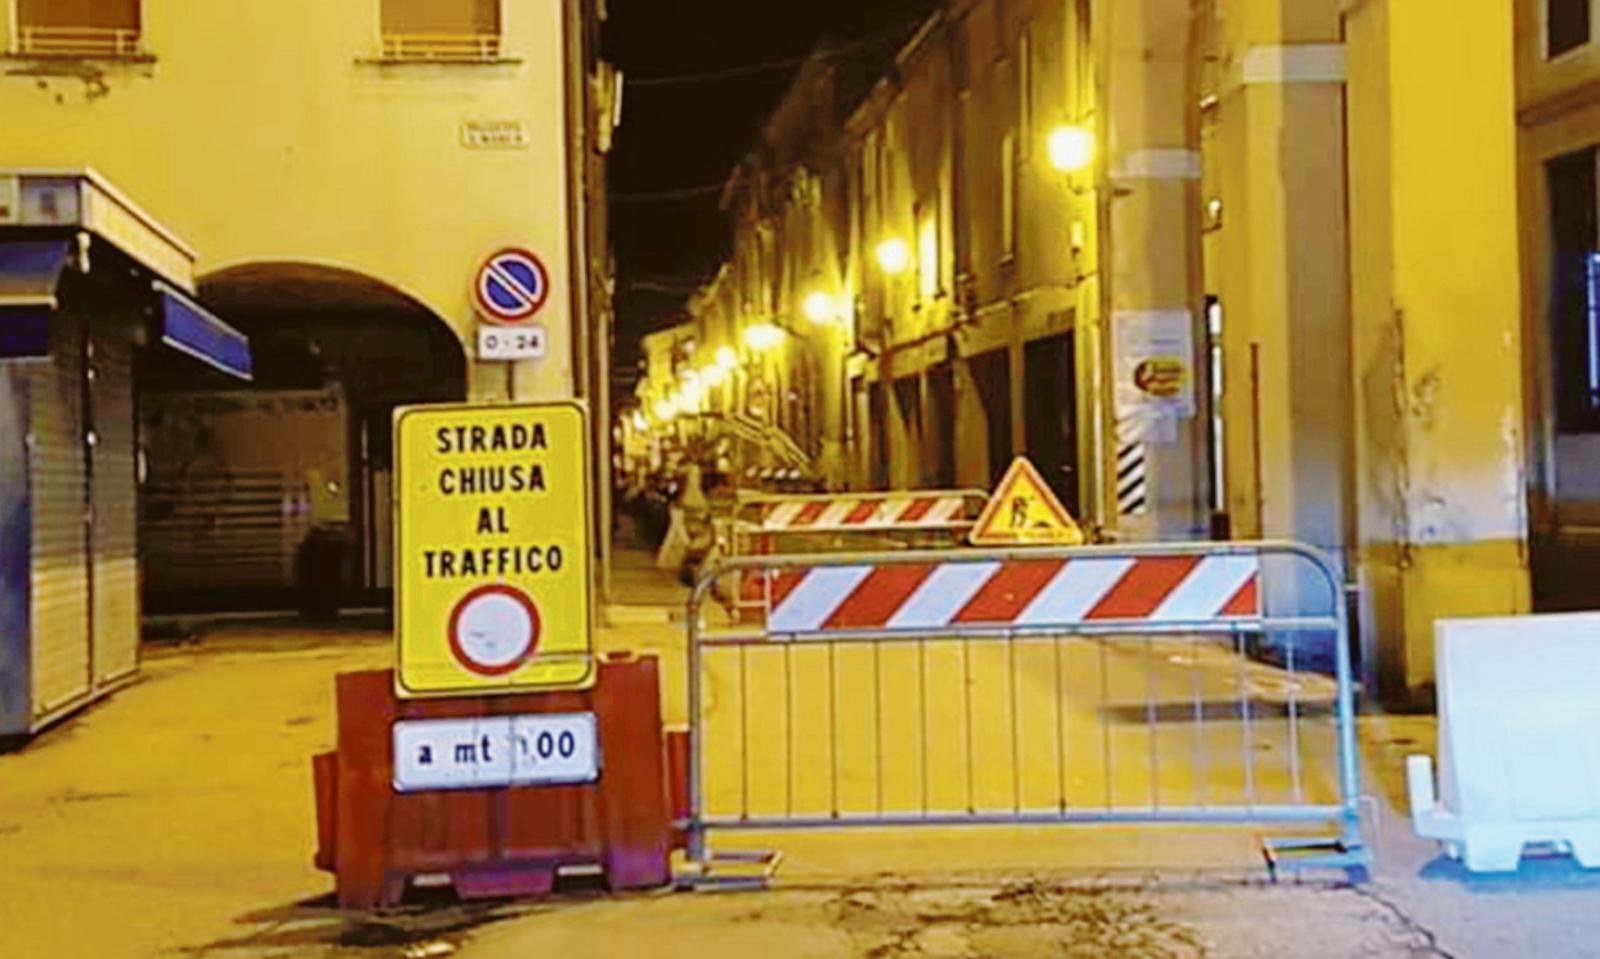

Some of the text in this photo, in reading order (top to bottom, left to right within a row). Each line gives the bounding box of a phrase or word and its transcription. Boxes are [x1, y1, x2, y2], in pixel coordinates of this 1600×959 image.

[516, 334, 540, 351] 24
[436, 423, 548, 454] STRADA
[439, 464, 546, 495] CHIUSA
[476, 507, 510, 534] AL
[424, 546, 563, 578] TRAFFICO
[418, 745, 433, 765] a
[454, 734, 492, 763] mt
